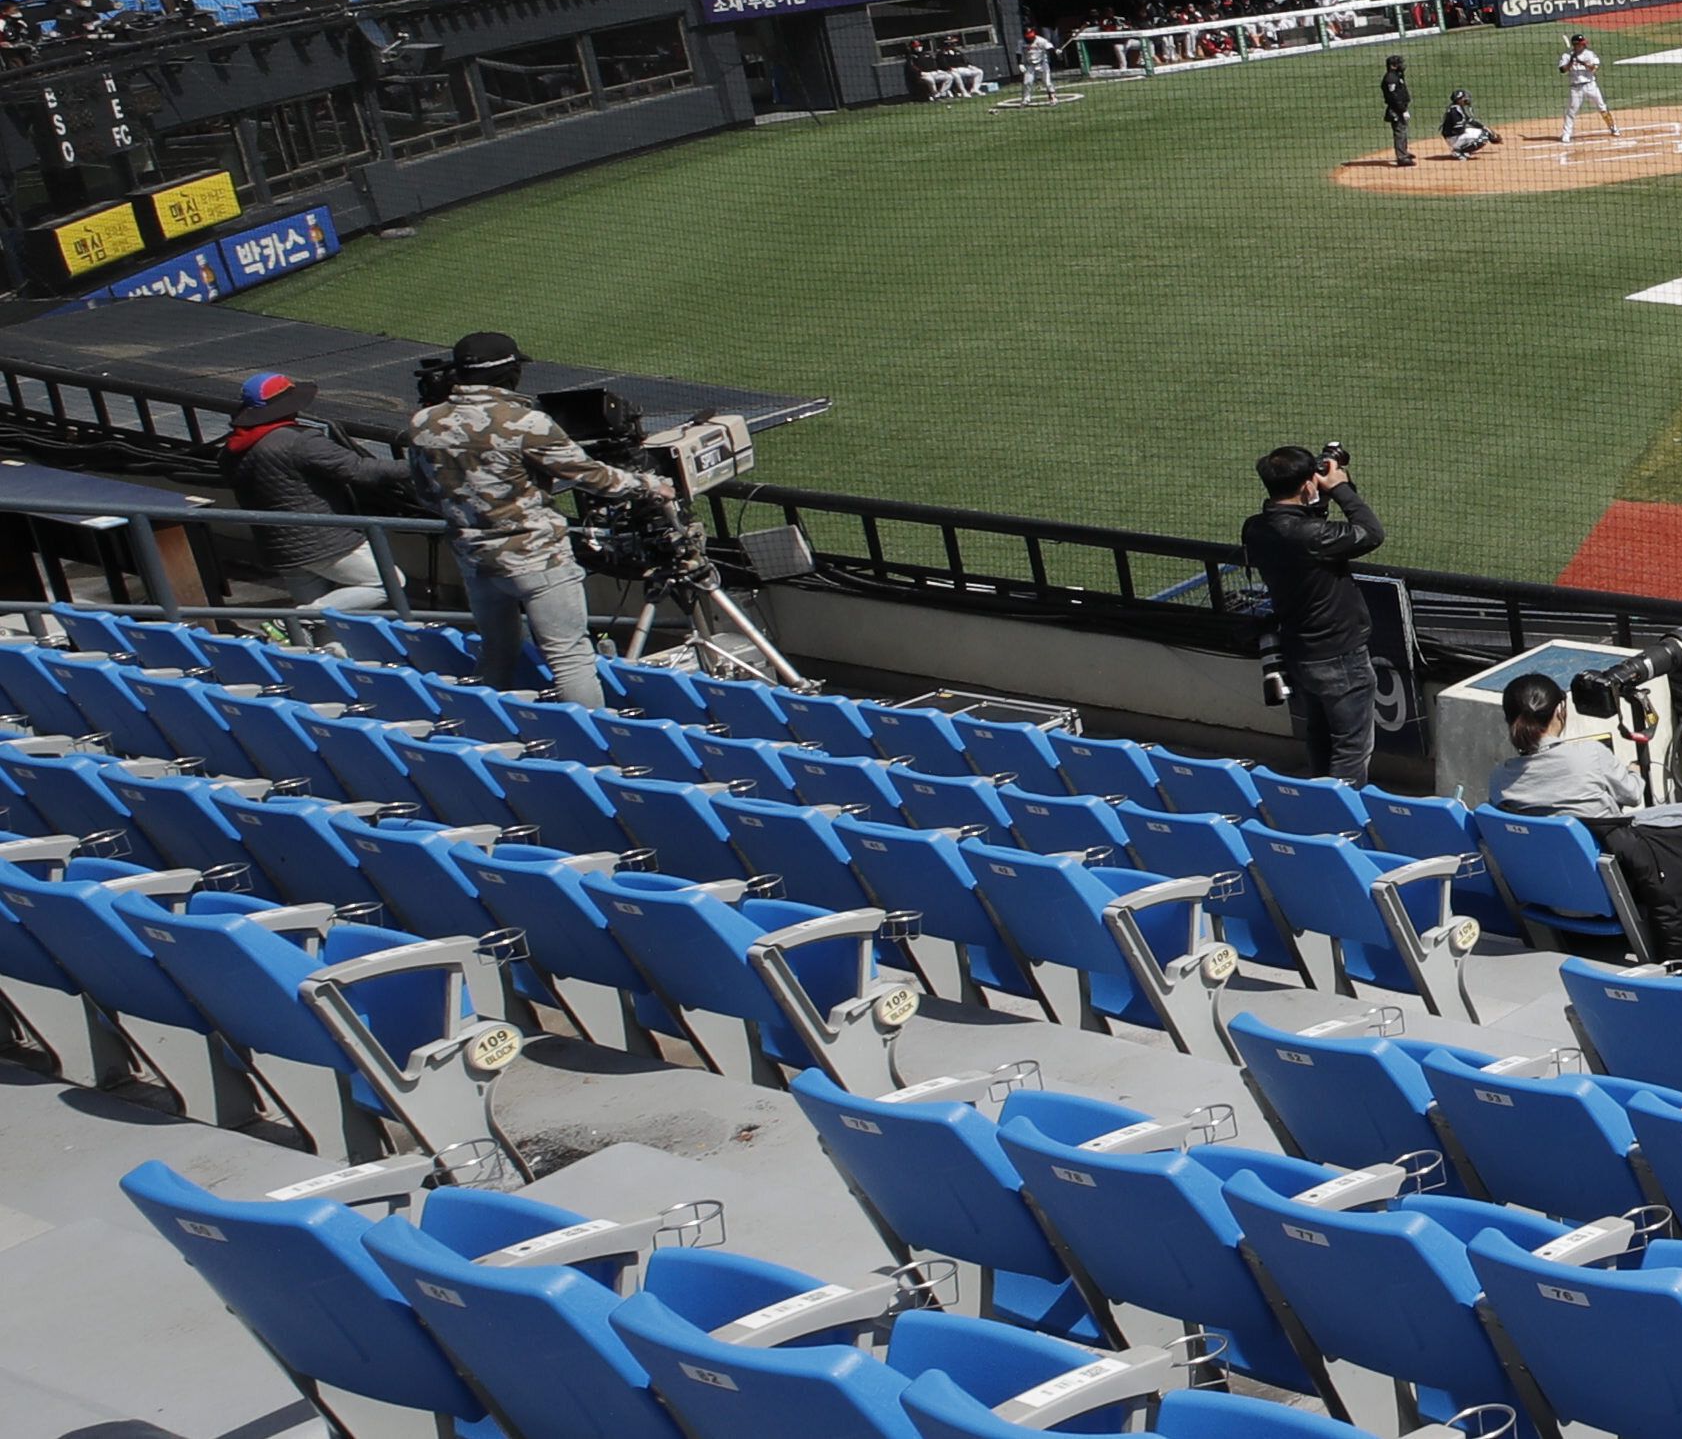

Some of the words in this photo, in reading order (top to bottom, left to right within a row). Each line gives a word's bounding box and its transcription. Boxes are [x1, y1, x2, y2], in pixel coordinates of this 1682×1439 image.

[111, 98, 124, 119] E
[53, 114, 67, 135] S
[112, 124, 132, 148] FC
[235, 229, 310, 275] 박카스
[1459, 922, 1473, 939] 109
[1211, 949, 1229, 966] 109
[1214, 960, 1233, 976] BLOCK
[885, 991, 908, 1010] 109
[889, 1003, 914, 1021] BLOCK
[478, 1030, 508, 1053] 109
[485, 1045, 517, 1066] BLOCK
[1064, 1171, 1083, 1182] 78
[1296, 1230, 1313, 1241] 77
[1551, 1289, 1574, 1301] 76
